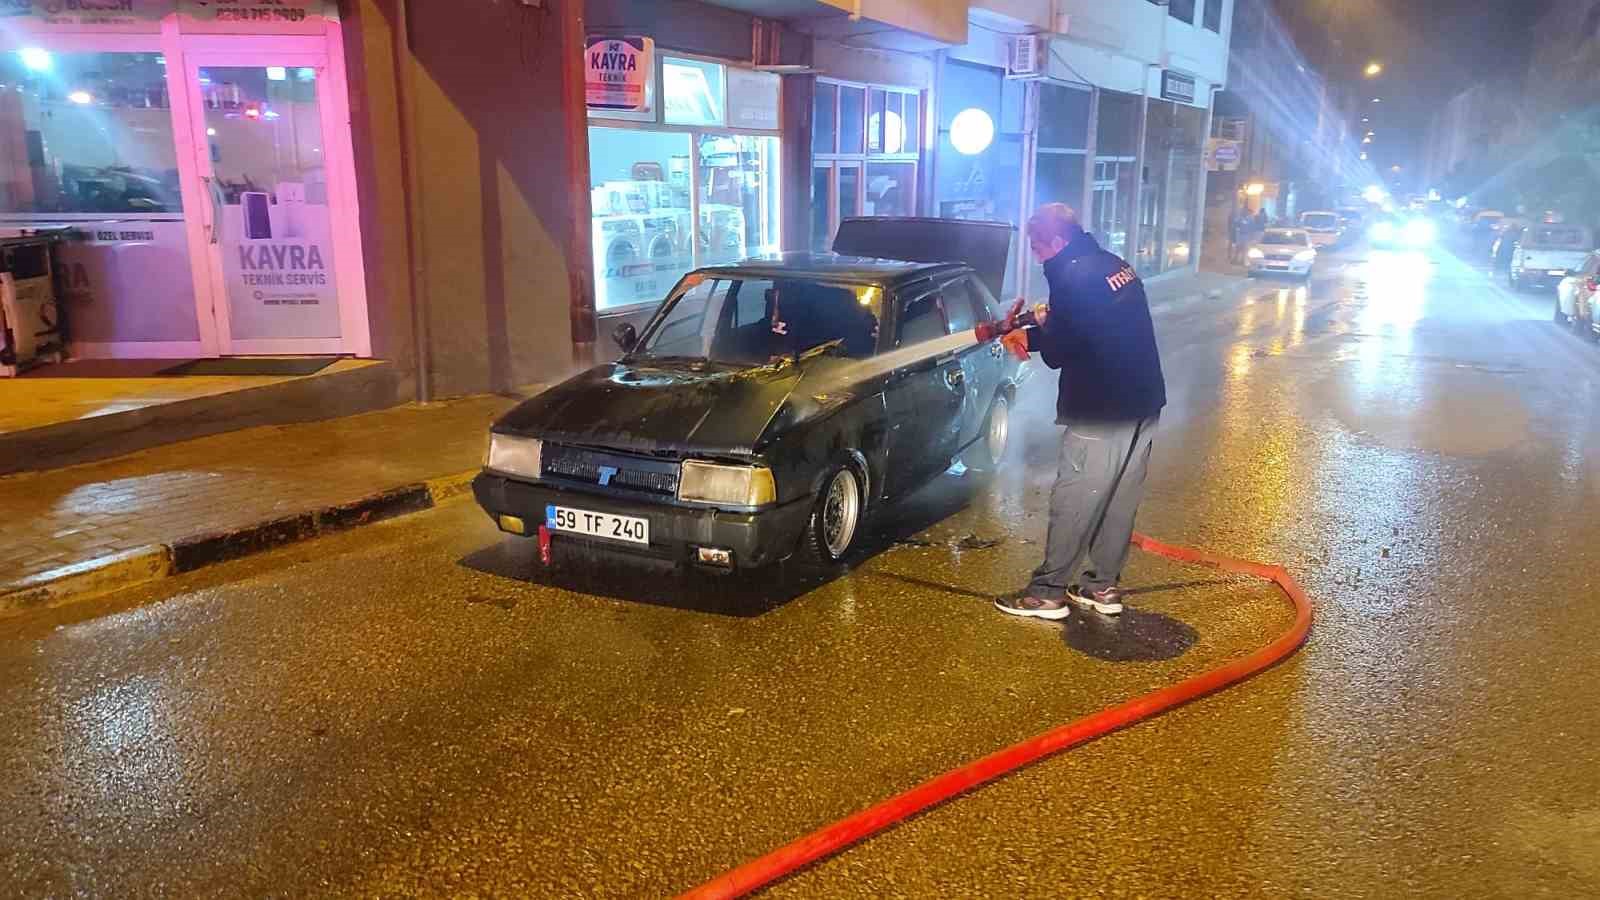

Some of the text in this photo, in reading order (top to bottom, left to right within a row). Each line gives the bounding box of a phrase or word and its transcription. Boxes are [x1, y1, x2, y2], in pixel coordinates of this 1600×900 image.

[591, 52, 636, 71] KAYRA
[239, 245, 324, 270] KAYRA
[556, 509, 576, 529] 59
[583, 513, 604, 532] TF
[612, 518, 644, 539] 240
